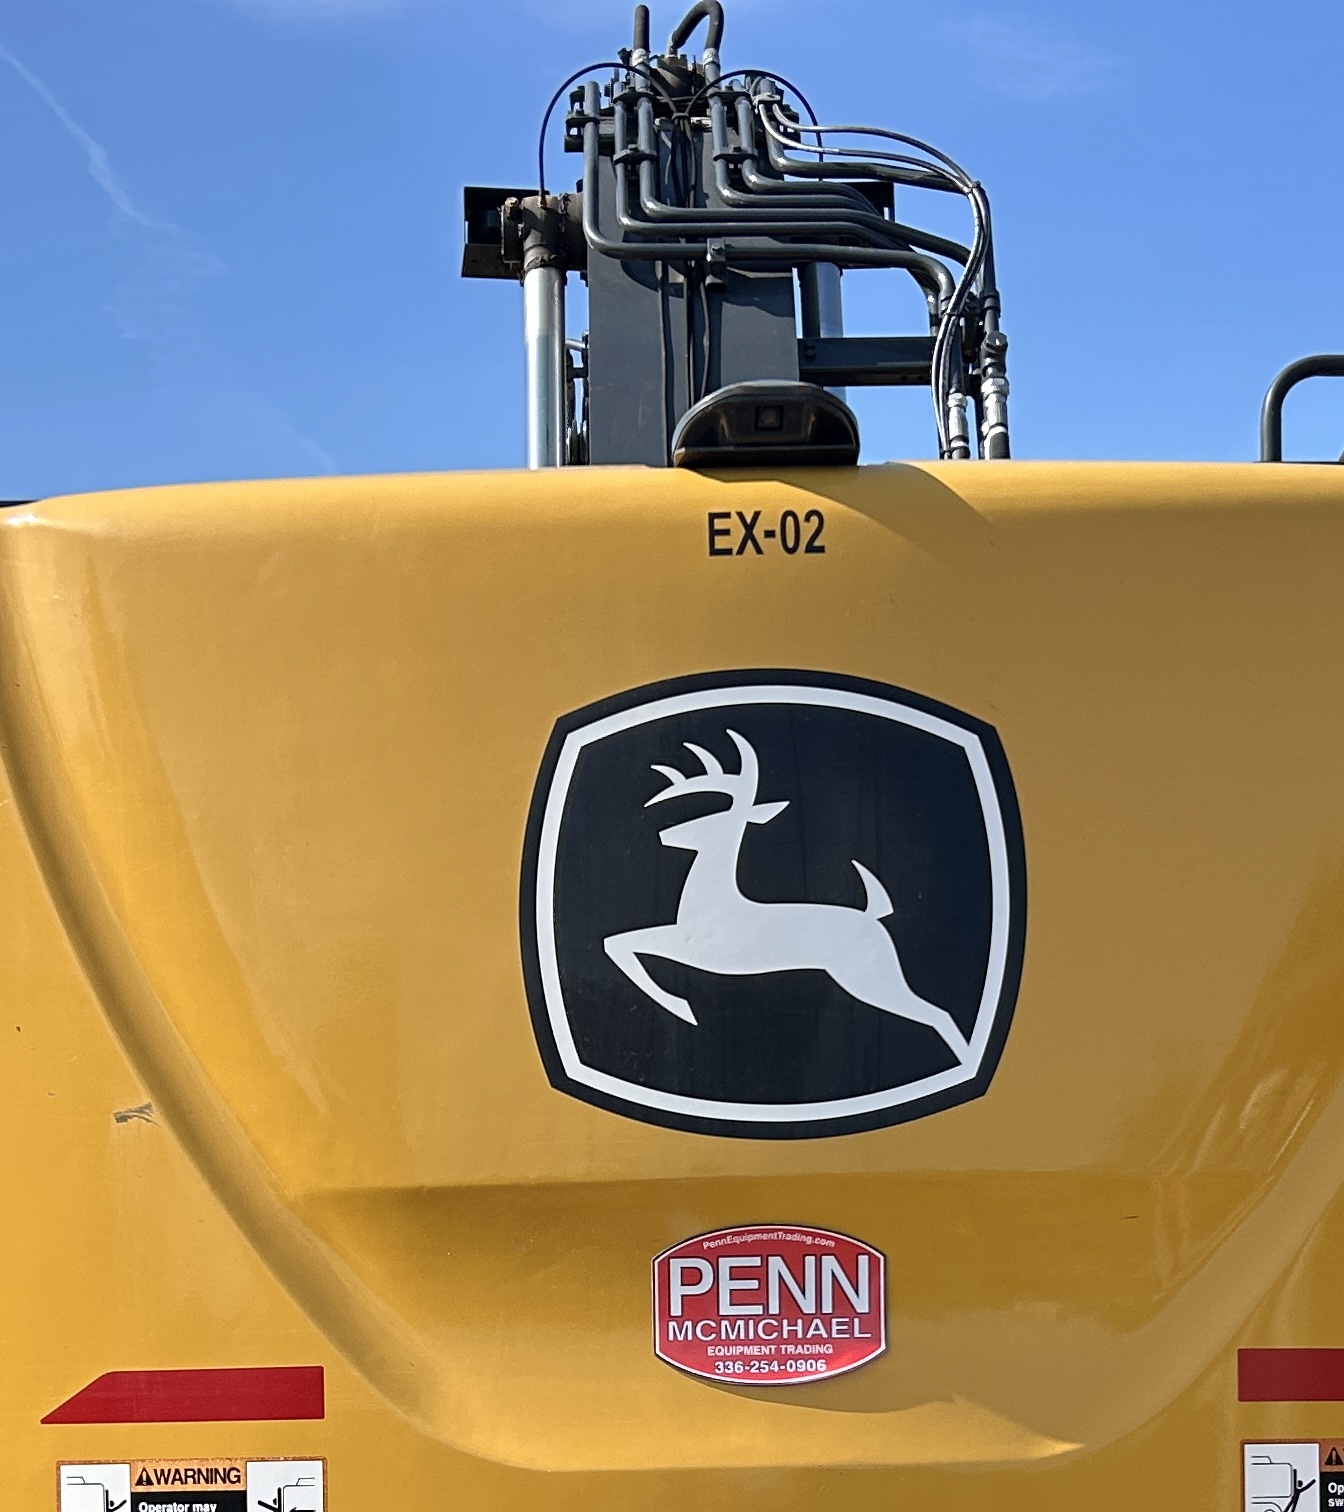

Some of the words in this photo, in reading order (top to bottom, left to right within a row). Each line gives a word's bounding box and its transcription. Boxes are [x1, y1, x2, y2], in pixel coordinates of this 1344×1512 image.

[708, 509, 825, 556] EX-02
[702, 1231, 836, 1250] PennEquipmentTrading.com
[668, 1254, 870, 1317] PENN
[668, 1318, 872, 1341] MCMICHAEL
[707, 1345, 776, 1357] EQUIPMENT
[779, 1344, 833, 1355] TRADING
[714, 1360, 827, 1374] 336-254-0906
[154, 1467, 241, 1485] WARNING
